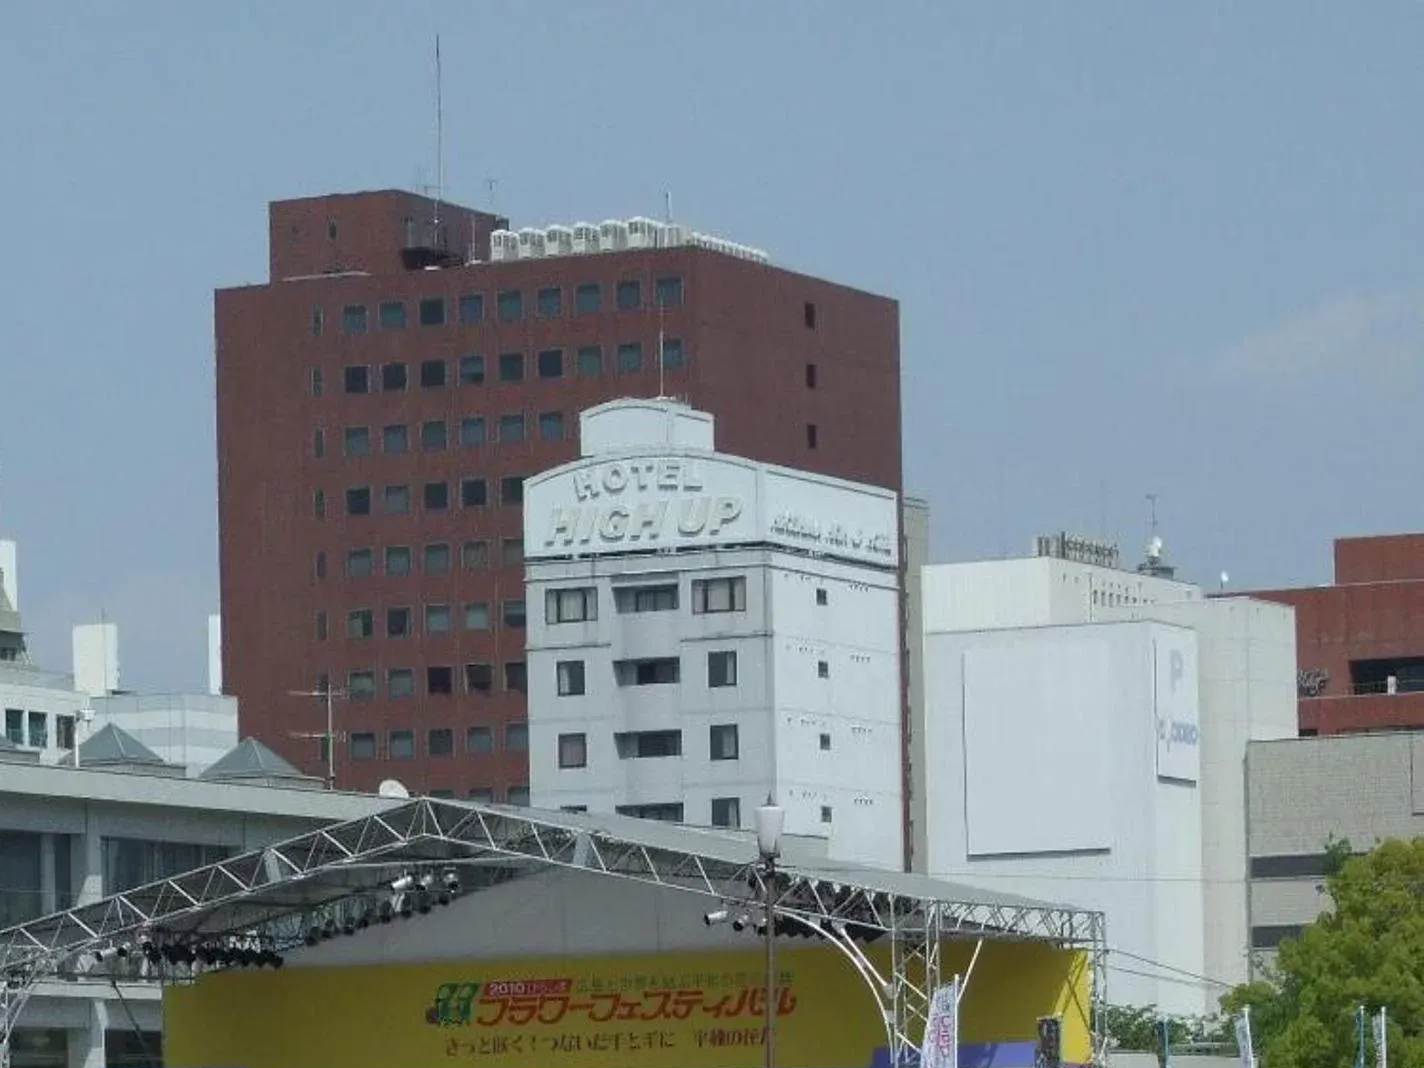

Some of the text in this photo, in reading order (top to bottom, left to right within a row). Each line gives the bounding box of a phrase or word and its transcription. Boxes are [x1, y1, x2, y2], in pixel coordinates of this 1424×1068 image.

[570, 463, 703, 502] HOTEL
[544, 500, 670, 548] HIGH
[675, 495, 744, 538] UP
[477, 986, 797, 1027] フラワーフェスティバル
